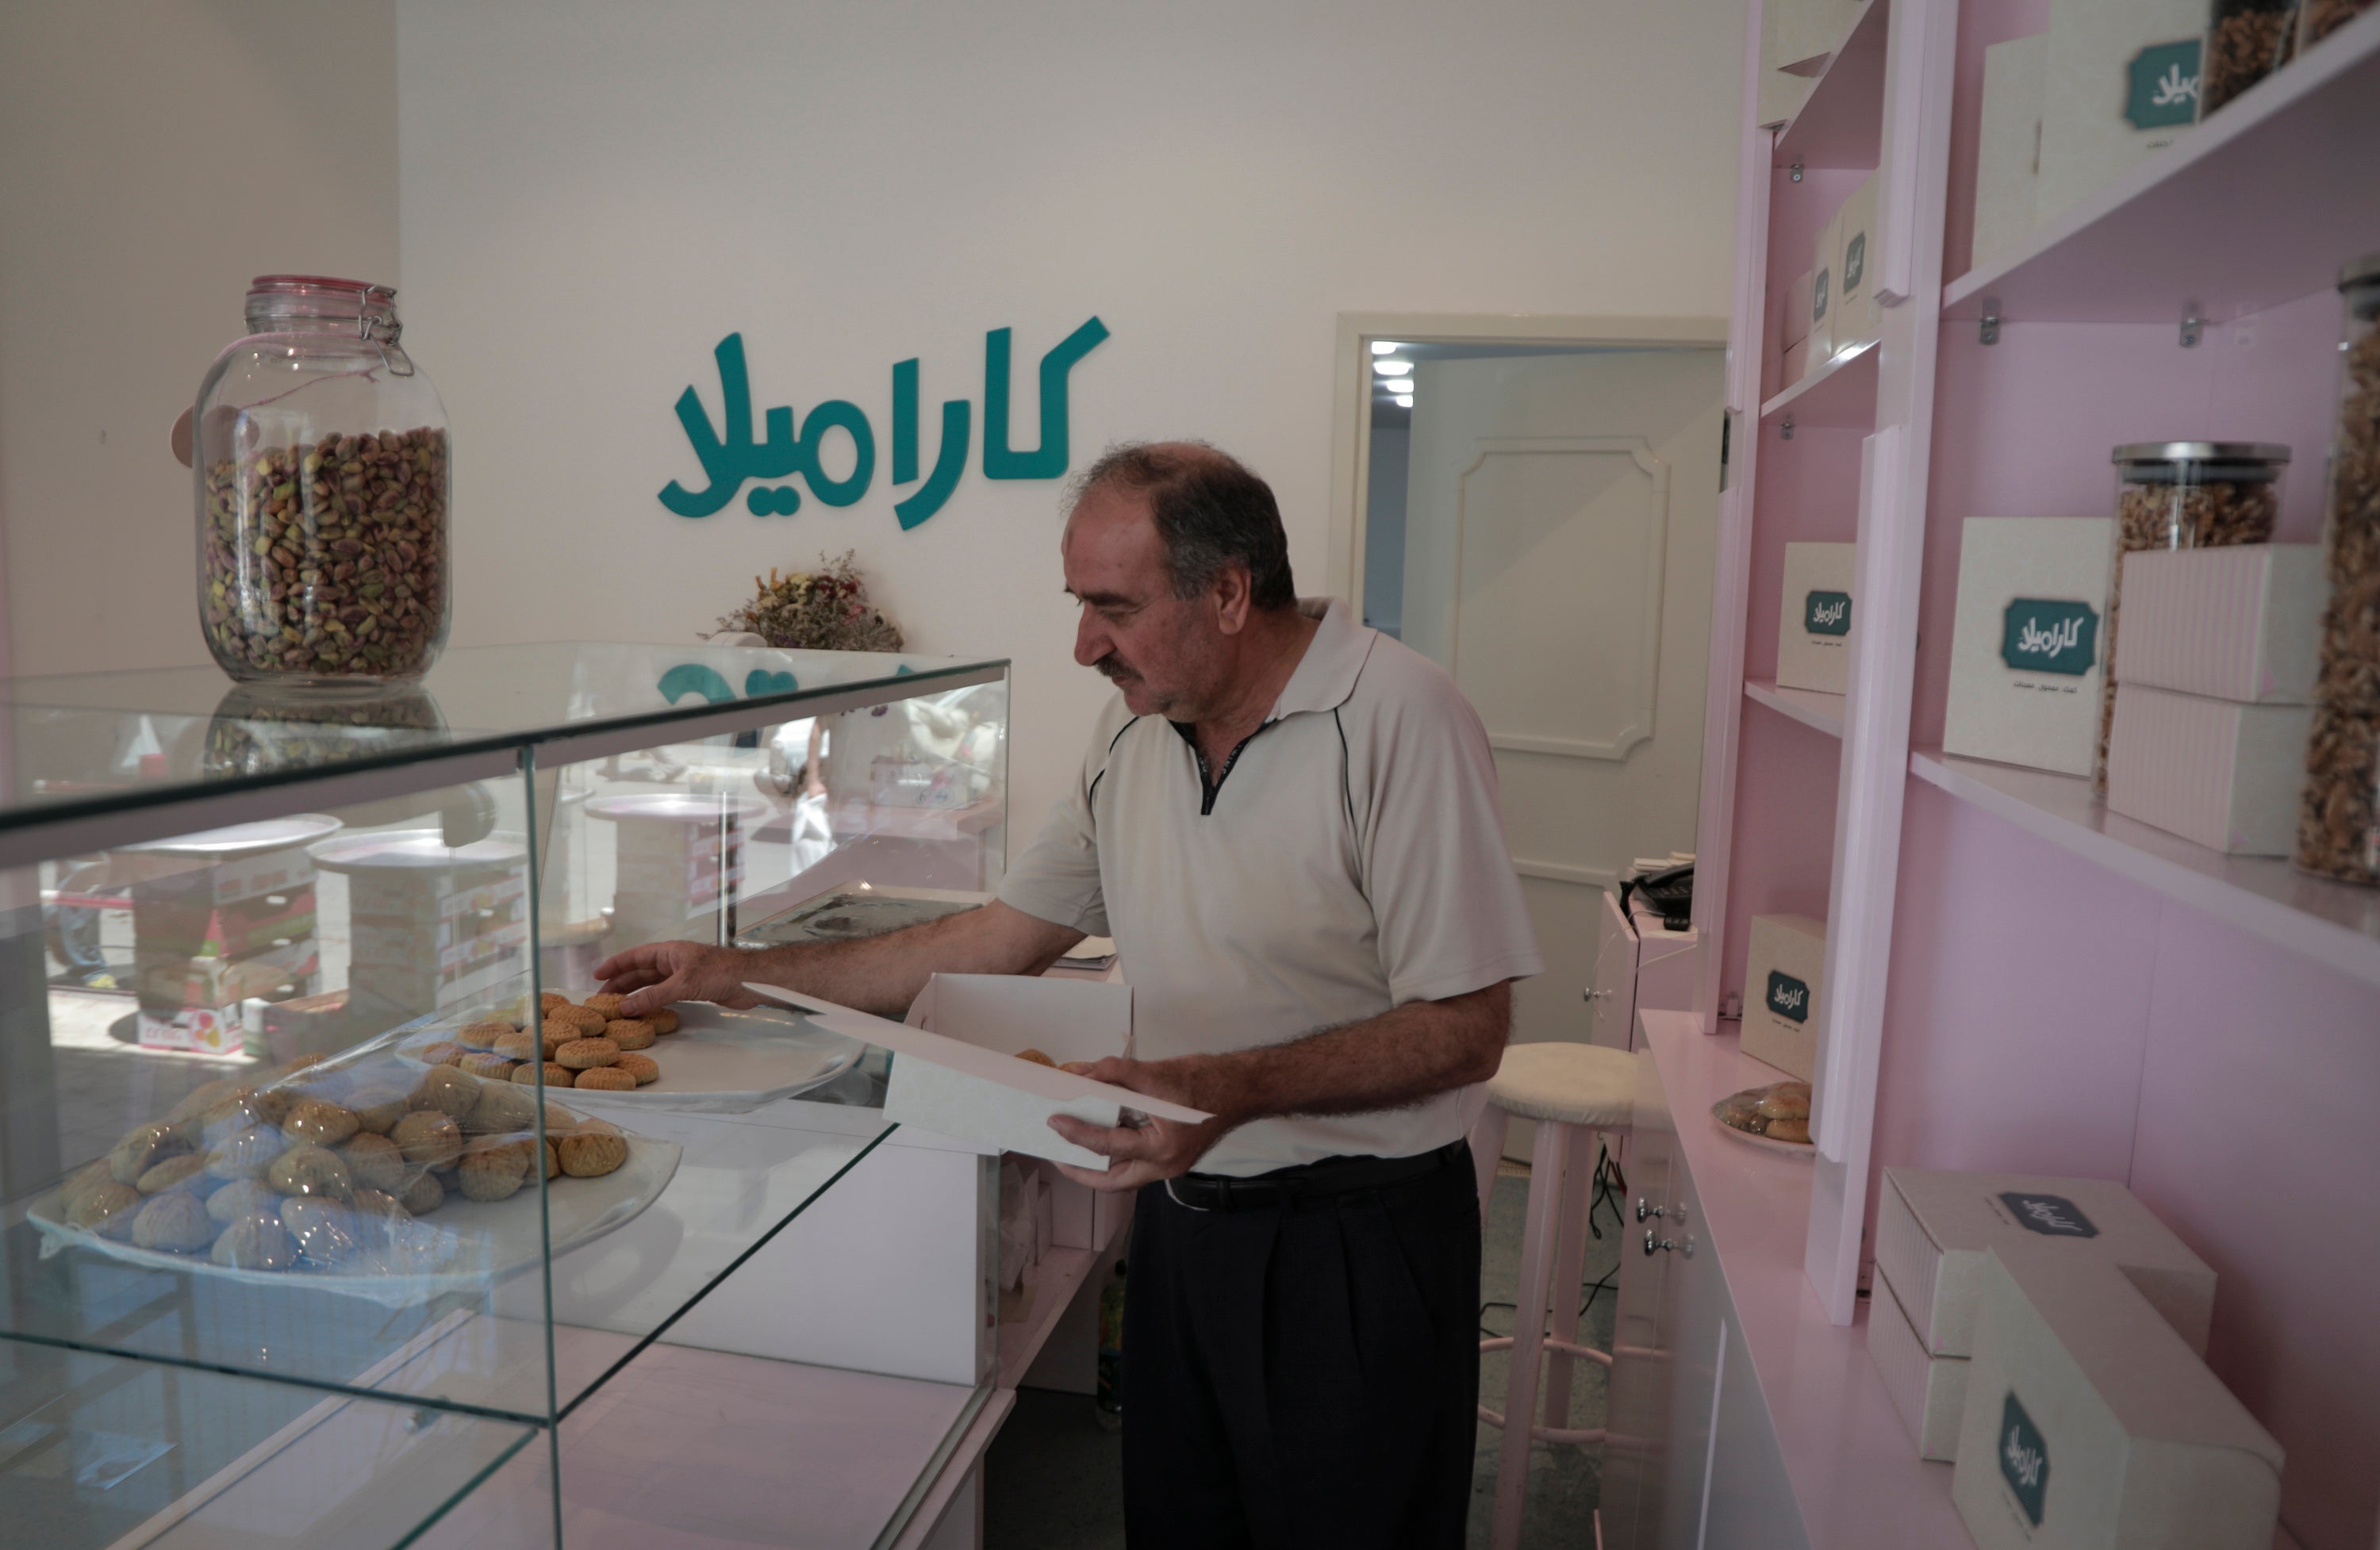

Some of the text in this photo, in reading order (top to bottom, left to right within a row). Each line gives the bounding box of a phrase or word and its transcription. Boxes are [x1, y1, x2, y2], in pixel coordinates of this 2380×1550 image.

[658, 315, 1111, 531] كاراميلا
[1813, 601, 1845, 626] كاراميلا
[2017, 616, 2084, 658] كاراميلا
[1774, 984, 1804, 1010] كاراميلا
